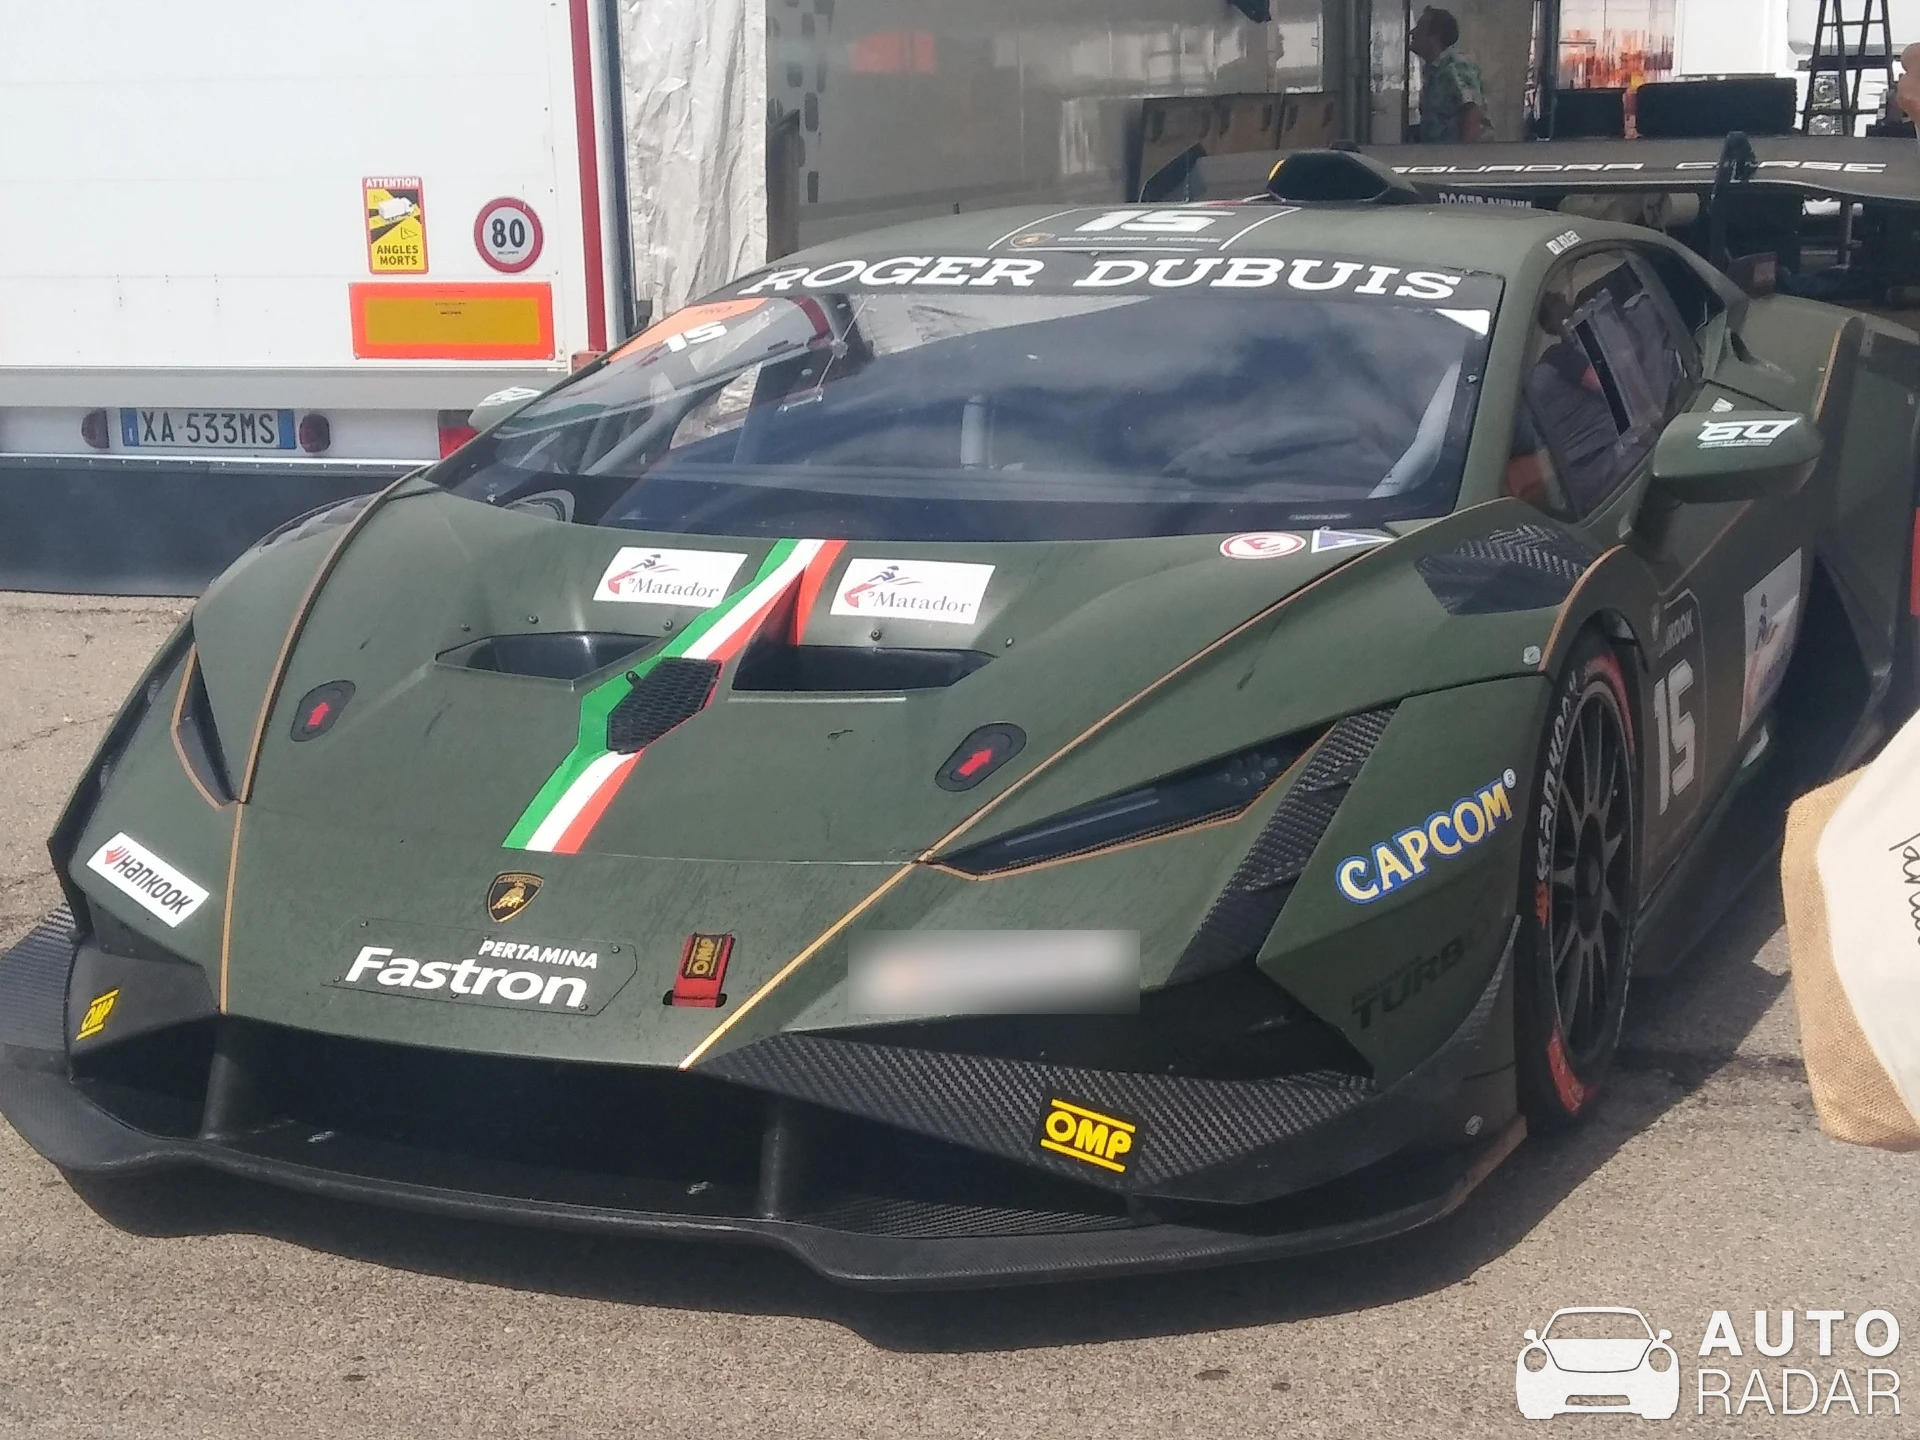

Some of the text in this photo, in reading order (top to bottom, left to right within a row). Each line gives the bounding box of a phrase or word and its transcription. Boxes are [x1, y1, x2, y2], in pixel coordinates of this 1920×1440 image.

[1675, 160, 1888, 174] CRSE
[366, 178, 419, 188] ATTENTION
[491, 218, 526, 248] 80
[1075, 210, 1236, 232] 15
[376, 245, 418, 255] ANGLES
[380, 255, 418, 265] MORTS
[737, 255, 1462, 300] ROGER DUBUIS
[662, 320, 728, 353] 15
[630, 577, 720, 598] Matador
[871, 591, 972, 613] Matador
[1654, 659, 1696, 816] 15
[478, 940, 598, 969] PERTAMINA
[692, 938, 715, 975] OMP
[345, 946, 588, 1007] Fastron
[80, 996, 115, 1032] OMP
[1046, 1110, 1132, 1160] OMP
